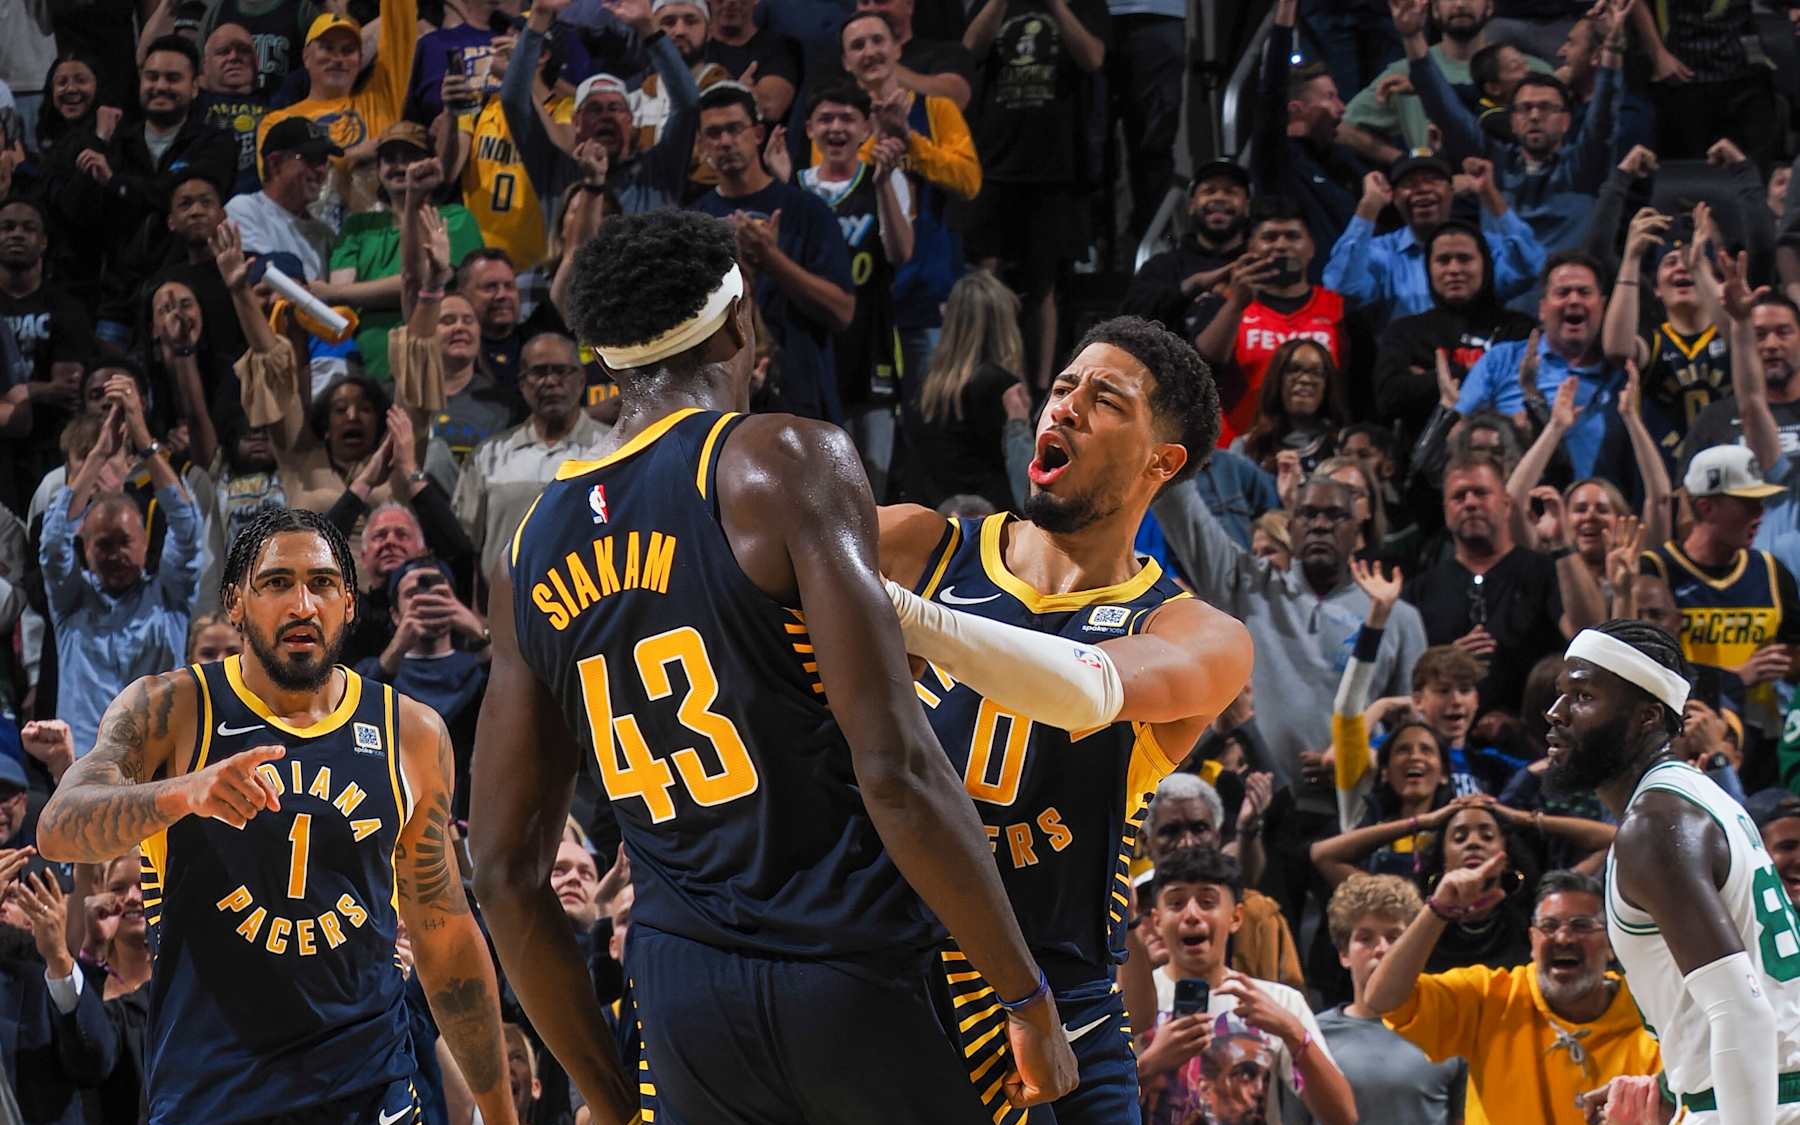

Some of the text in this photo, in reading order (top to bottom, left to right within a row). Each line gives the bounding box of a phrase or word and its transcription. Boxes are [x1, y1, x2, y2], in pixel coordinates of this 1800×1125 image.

[532, 531, 676, 631] SIAKAM
[577, 626, 759, 824] 43
[963, 698, 1034, 806] 0
[256, 760, 382, 842] DIANA
[287, 813, 312, 900] 1
[216, 884, 368, 957] PACERS
[1752, 863, 1800, 982] 8
